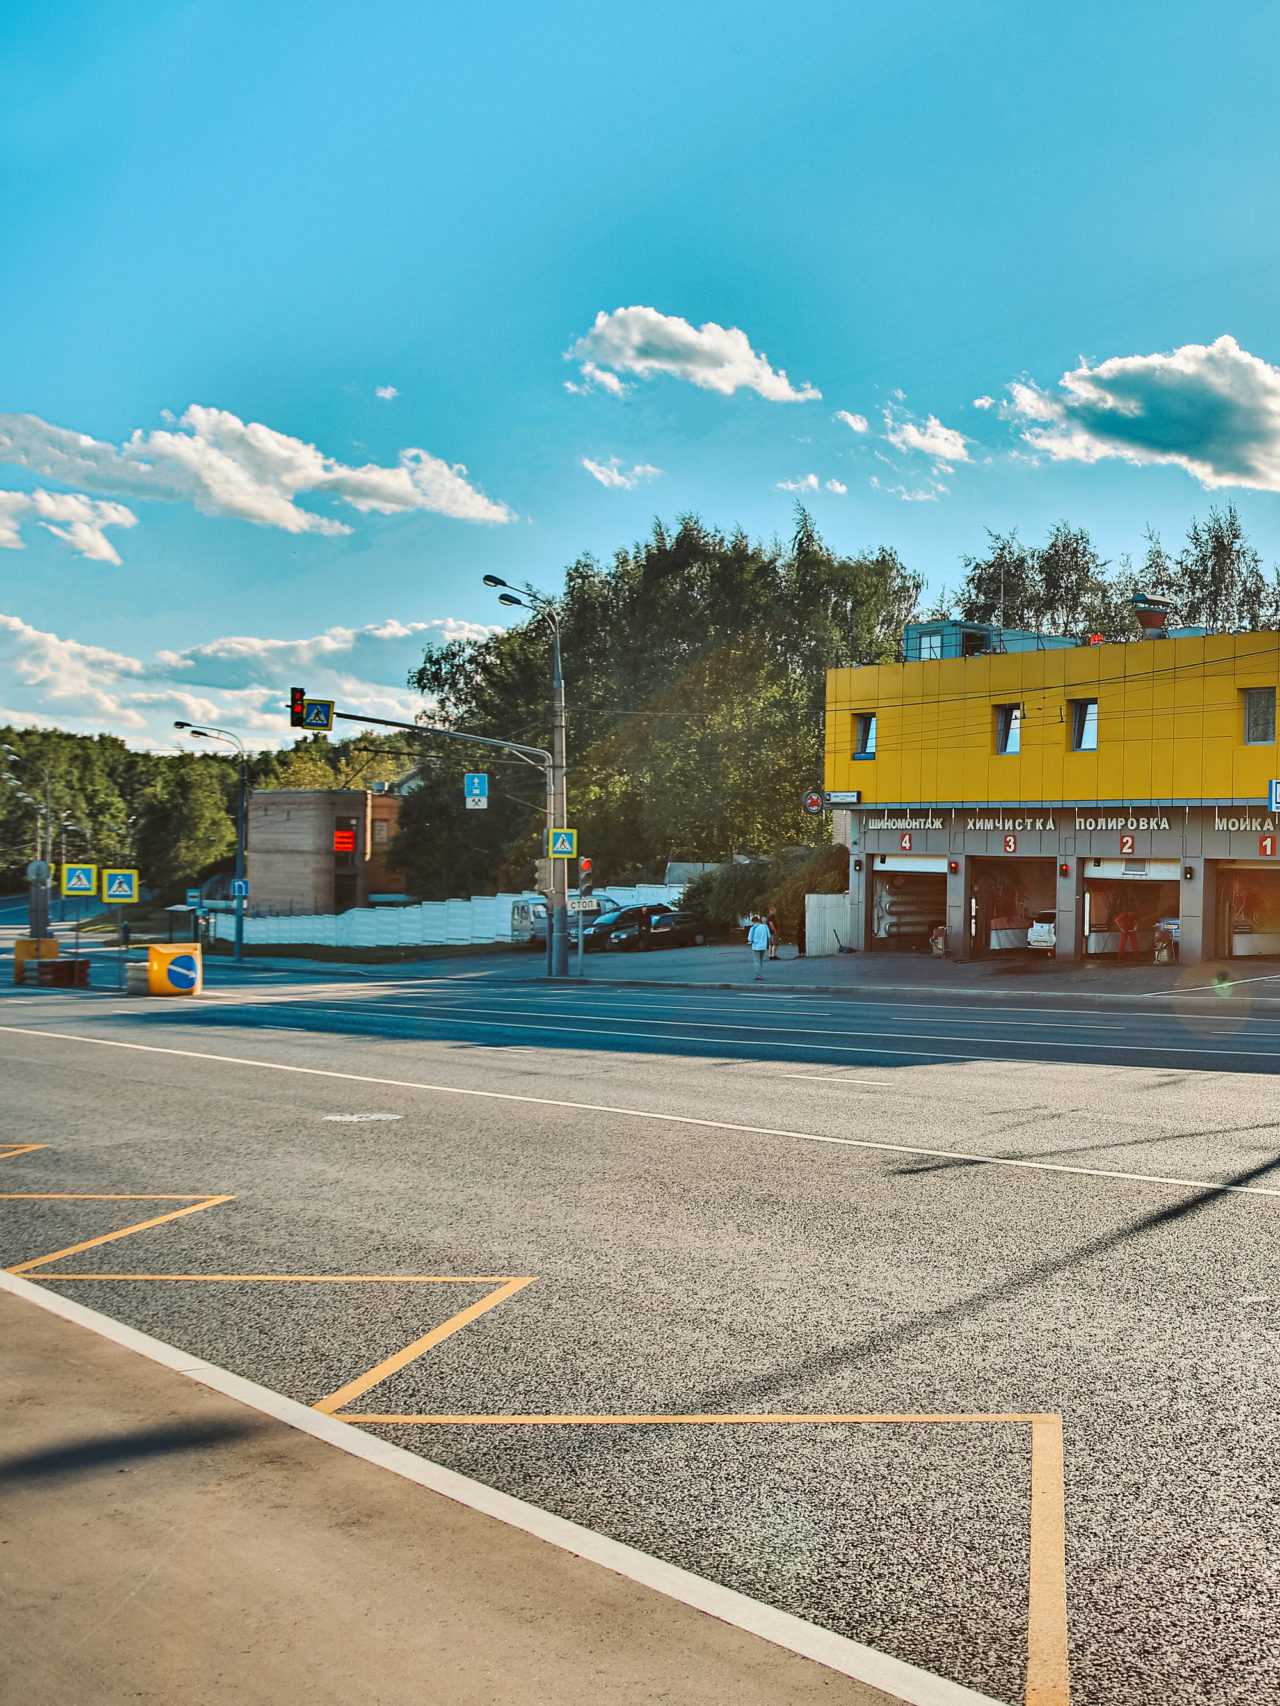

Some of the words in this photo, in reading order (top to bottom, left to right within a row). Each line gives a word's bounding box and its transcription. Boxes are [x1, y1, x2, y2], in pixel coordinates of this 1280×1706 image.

[868, 817, 943, 830] ШИНОМОНТАЖ
[967, 817, 1055, 831] ХИМЧИСТКА
[1075, 817, 1170, 830] ПОЛИРОВКА
[1215, 815, 1274, 831] МОЙКА
[901, 834, 911, 850] 4
[1005, 835, 1015, 852] 3
[1121, 837, 1133, 853] 2
[1262, 838, 1272, 855] 1
[570, 900, 593, 909] СТОП
